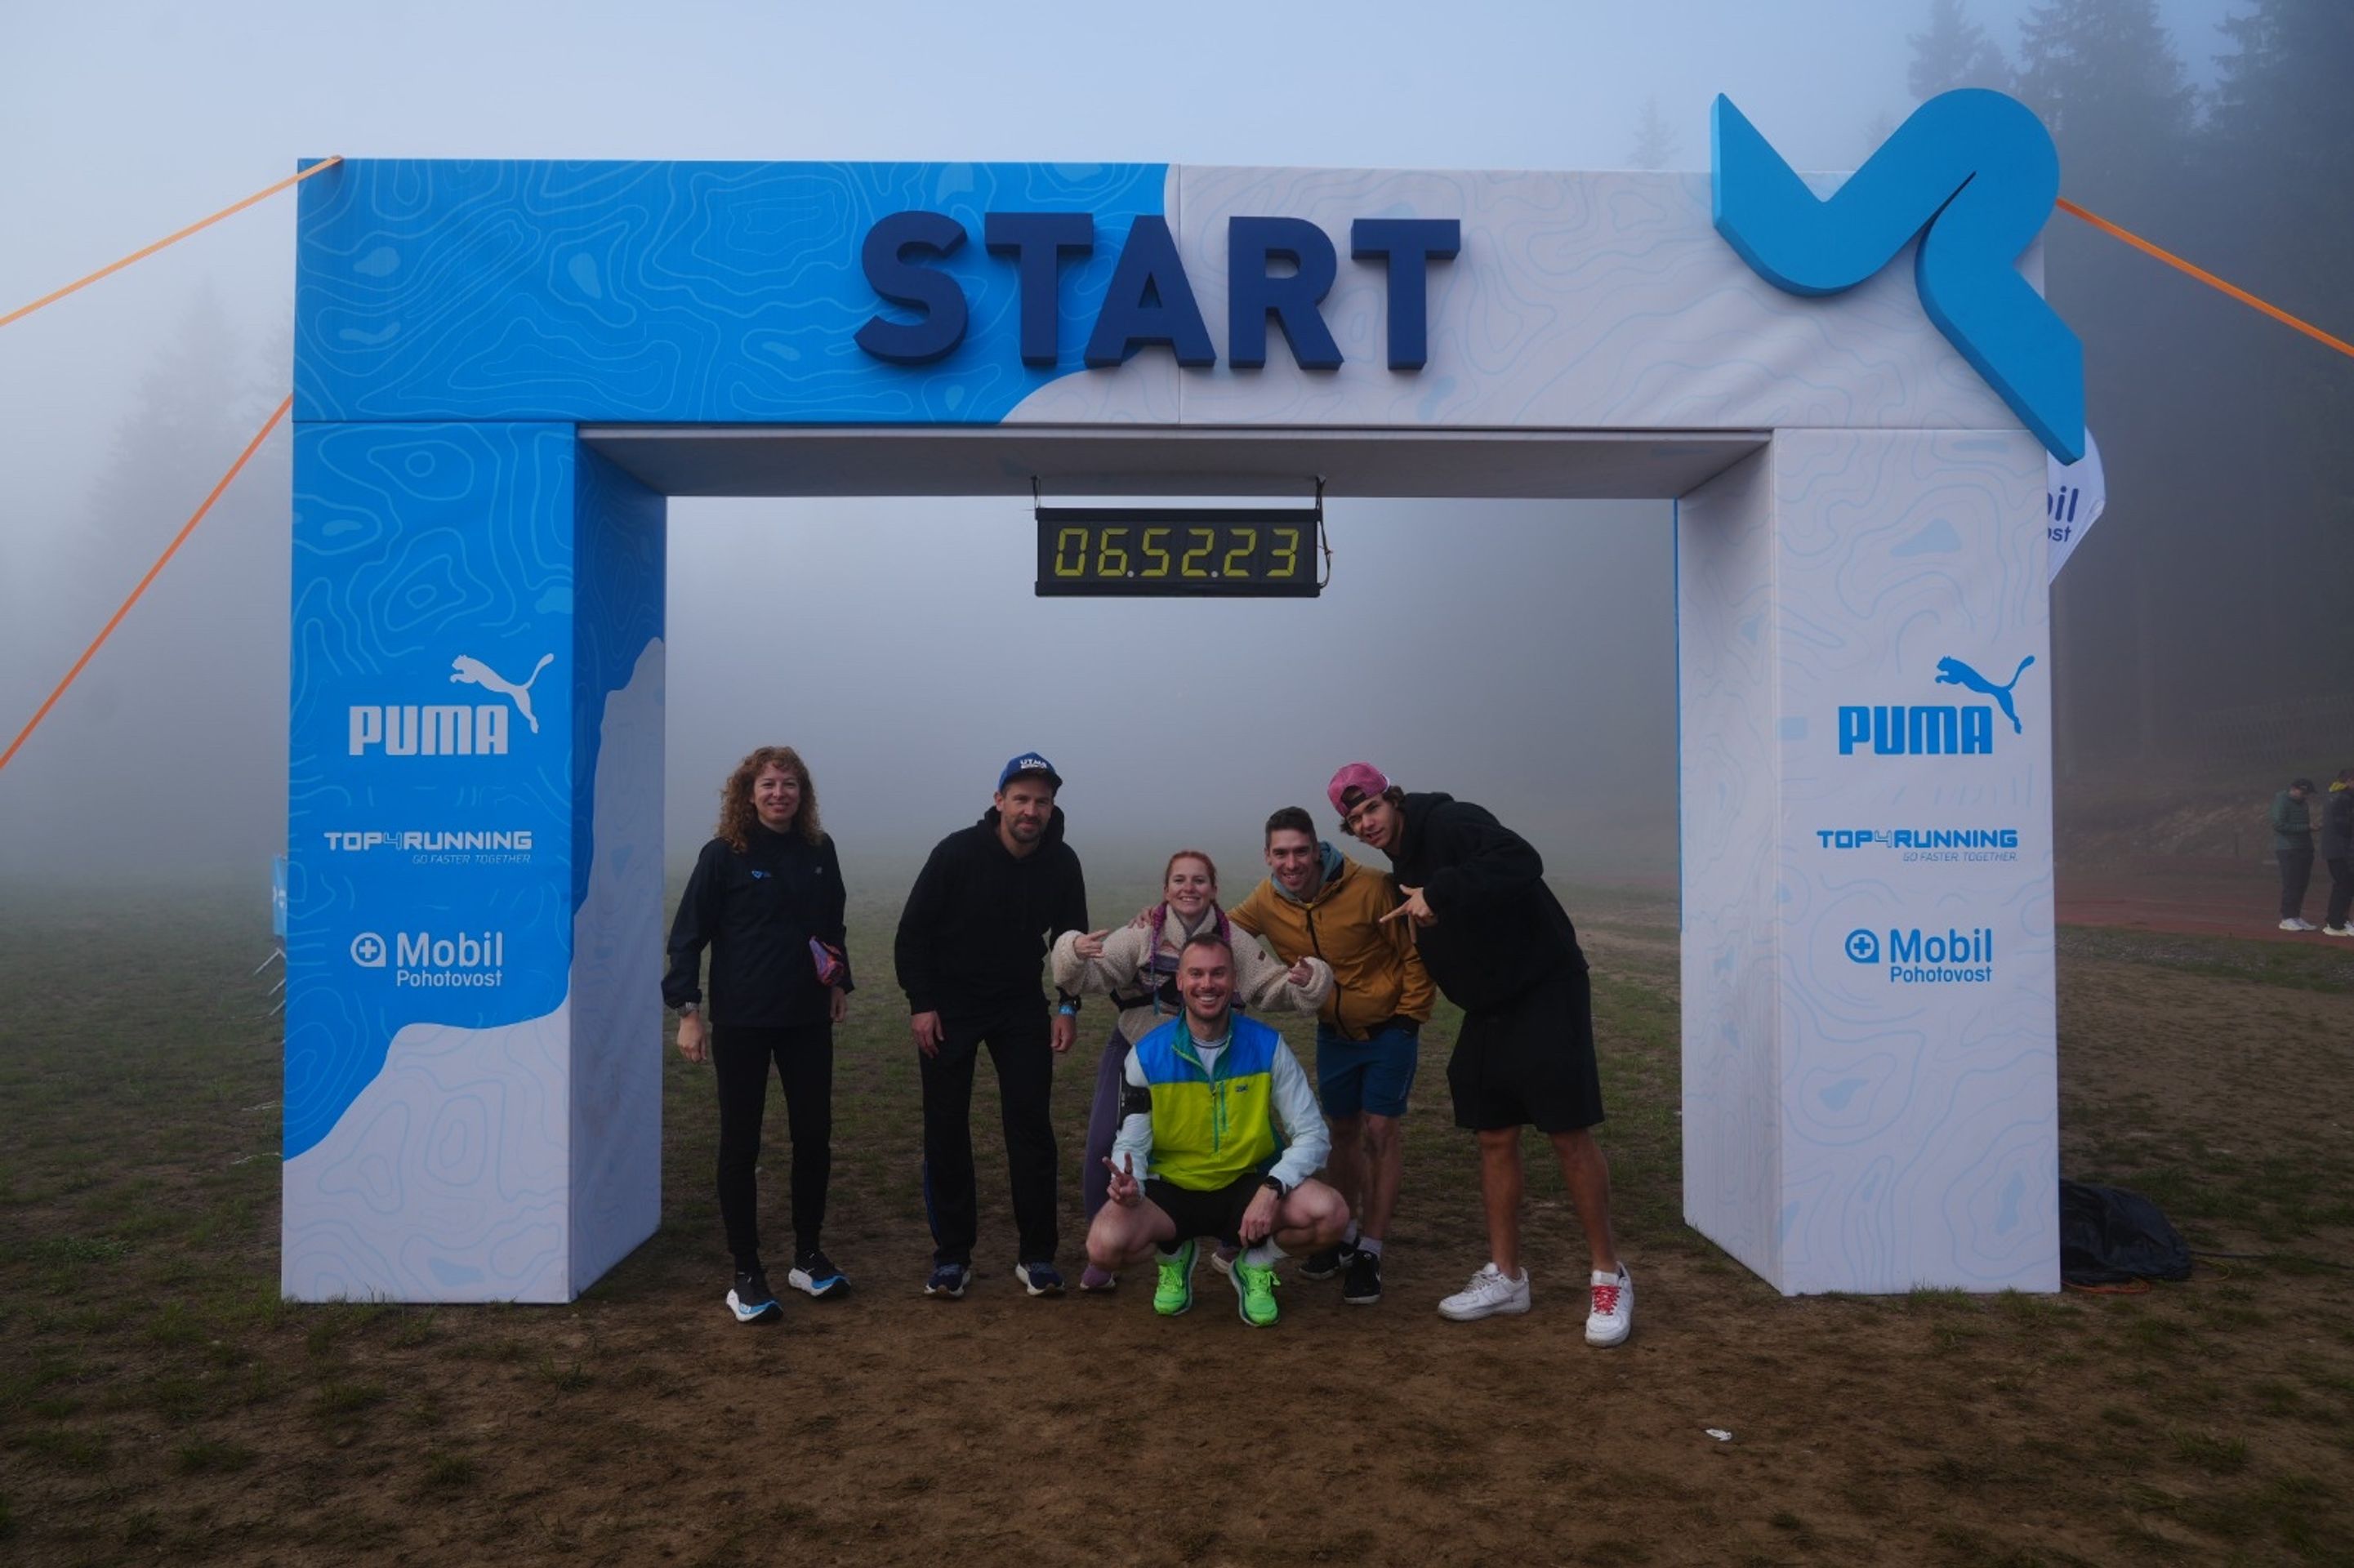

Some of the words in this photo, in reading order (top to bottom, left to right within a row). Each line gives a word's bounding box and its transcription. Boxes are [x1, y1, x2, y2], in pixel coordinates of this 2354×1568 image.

[854, 210, 1460, 371] START
[2048, 486, 2079, 523] il
[349, 705, 509, 755] PUMA
[1839, 706, 1993, 755] PUMA
[324, 831, 532, 850] TOP4RUNNING
[1817, 830, 2018, 849] TOP4RUNNING
[412, 854, 428, 864] GO
[1903, 852, 1918, 862] GO
[397, 931, 503, 967] Mobil
[1890, 929, 1992, 963] Mobil
[397, 970, 502, 987] Pohotovost
[1890, 966, 1992, 982] Pohotovost
